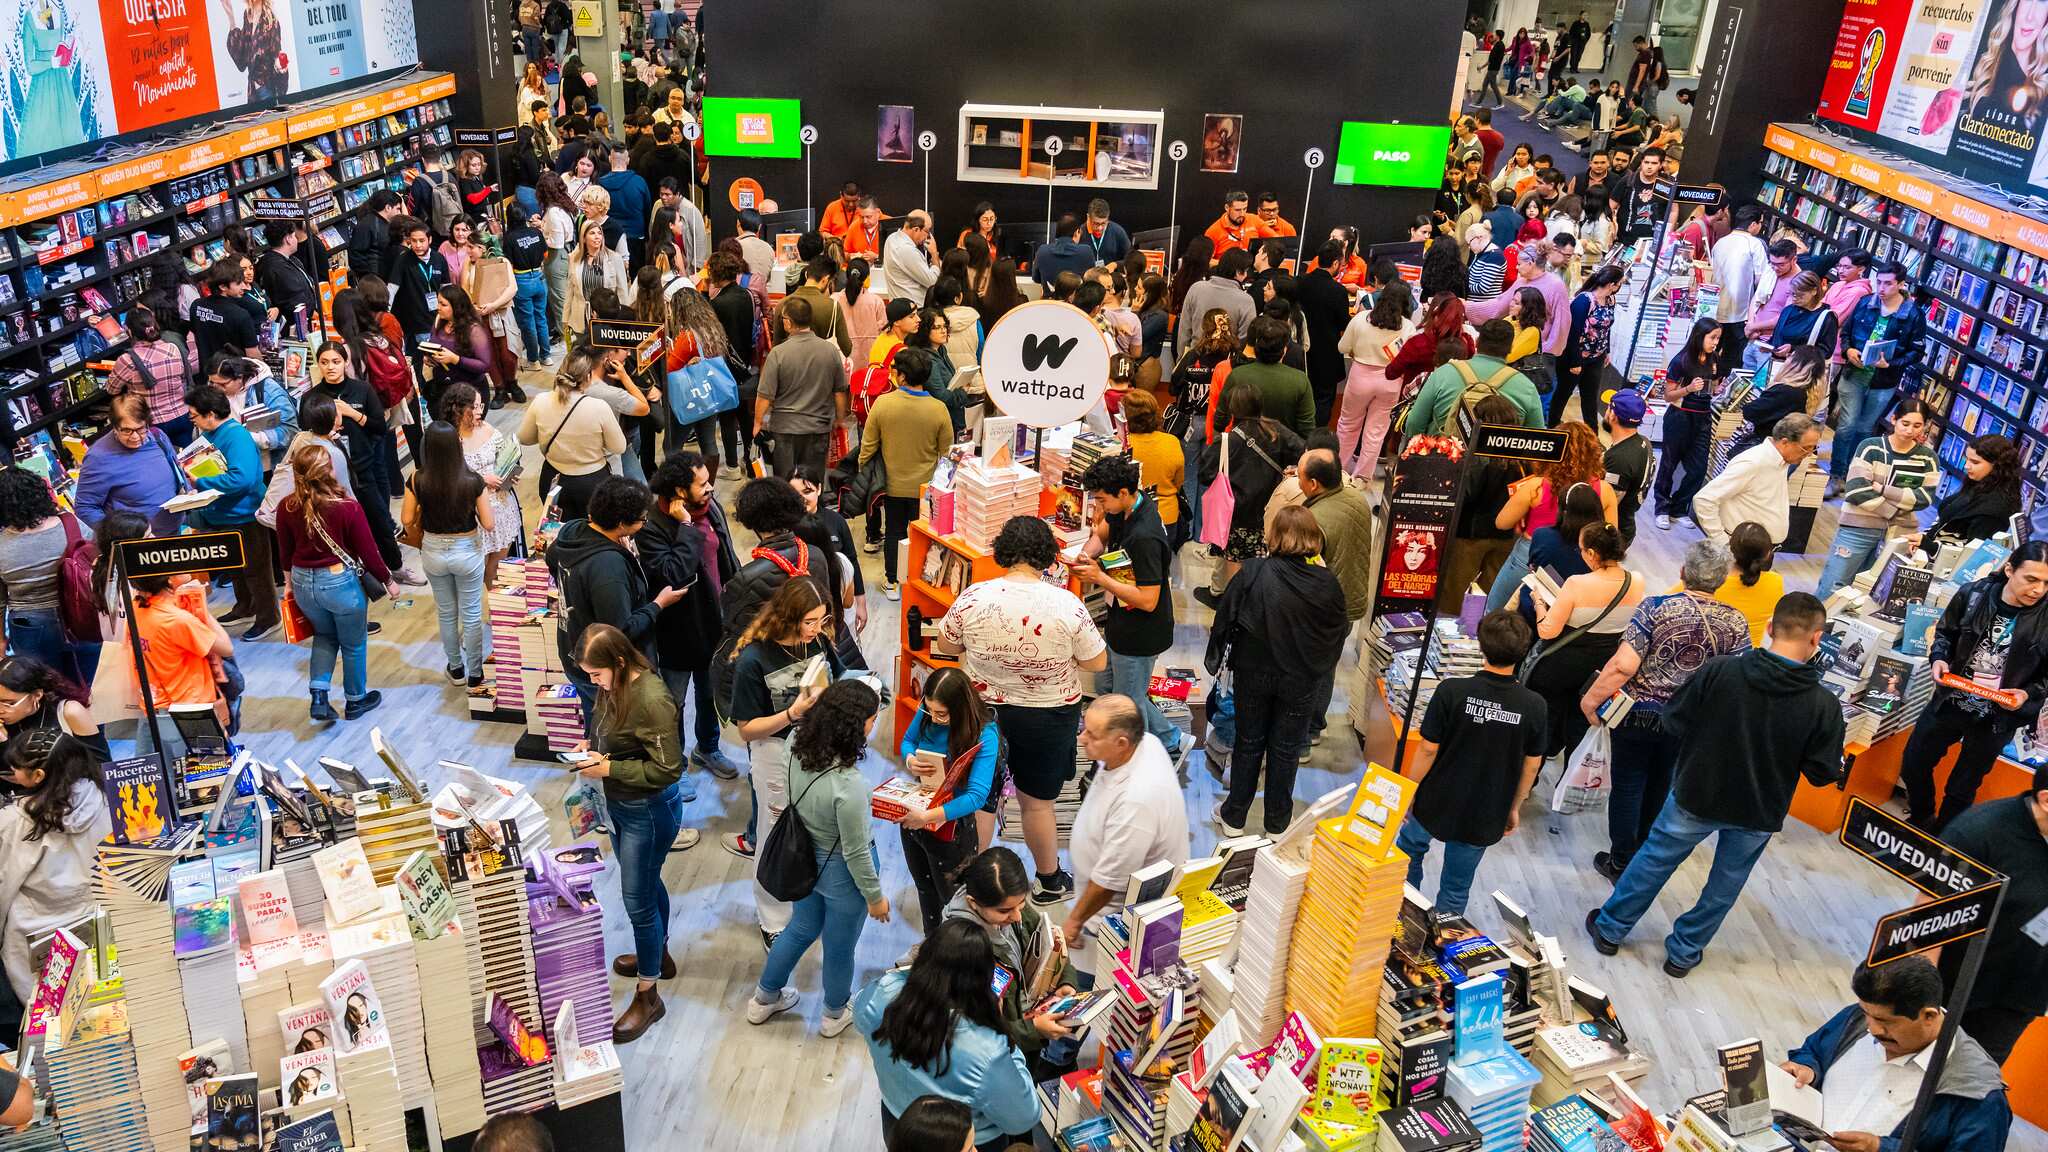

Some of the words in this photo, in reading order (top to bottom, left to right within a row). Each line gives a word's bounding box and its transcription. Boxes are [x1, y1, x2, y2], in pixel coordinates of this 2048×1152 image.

[307, 9, 323, 26] DEL
[326, 4, 348, 22] TODO
[1922, 4, 1974, 23] recuerdos
[1936, 36, 1949, 50] sin
[160, 47, 186, 82] capital
[1706, 18, 1734, 121] ENTRADA
[1908, 64, 1952, 85] porvenir
[132, 66, 198, 108] Movimiento
[1986, 108, 2017, 126] LÍDER
[460, 134, 490, 142] NOVEDADES
[688, 125, 695, 137] 1
[804, 129, 813, 142] 2
[1959, 113, 2035, 150] Clariconectado
[922, 135, 932, 148] 3
[1048, 140, 1058, 152] 4
[1173, 146, 1183, 158] 5
[1309, 152, 1319, 165] 6
[1373, 150, 1410, 162] PASO
[1851, 163, 1880, 184] ALFAGUARA
[1679, 190, 1716, 201] NOVEDADES
[1900, 181, 1934, 204] ALFAGUARA
[272, 202, 286, 210] VIVIR
[286, 202, 299, 210] UNA
[1952, 204, 1990, 229] ALFAGUARA
[1001, 379, 1084, 400] wattpad
[1486, 435, 1554, 452] NOVEDADES
[138, 545, 228, 566] NOVEDADES
[1384, 572, 1400, 581] LAS
[1400, 572, 1438, 584] SEÑORAS
[1900, 568, 1930, 580] ARTURO
[1388, 581, 1402, 590] DEL
[1467, 696, 1476, 704] SEA
[1465, 704, 1484, 717] DILO
[1486, 708, 1520, 724] PENGUIN
[105, 763, 158, 781] Placeres
[117, 772, 162, 788] ocultos
[1864, 822, 1974, 892] NOVEDADES
[415, 864, 435, 890] REY
[258, 891, 272, 900] 30
[420, 883, 446, 915] CASH
[248, 897, 288, 912] SUNSETS
[256, 907, 282, 917] PARA
[1888, 904, 1981, 947] NOVEDADES
[331, 971, 366, 1000] VENTANA
[286, 1010, 329, 1031] VENTANA
[1418, 1055, 1438, 1064] COSAS
[1422, 1048, 1434, 1056] LAS
[285, 1054, 330, 1071] VENTANA
[1414, 1064, 1428, 1072] QUE
[1340, 1068, 1364, 1080] WTF
[1420, 1066, 1446, 1078] DIJERON
[1325, 1080, 1374, 1092] INFONAVIT
[213, 1094, 254, 1111] LASCIVIA
[1540, 1108, 1557, 1120] LO
[1557, 1102, 1581, 1114] QUE
[302, 1126, 312, 1137] El
[292, 1132, 328, 1150] PODER
